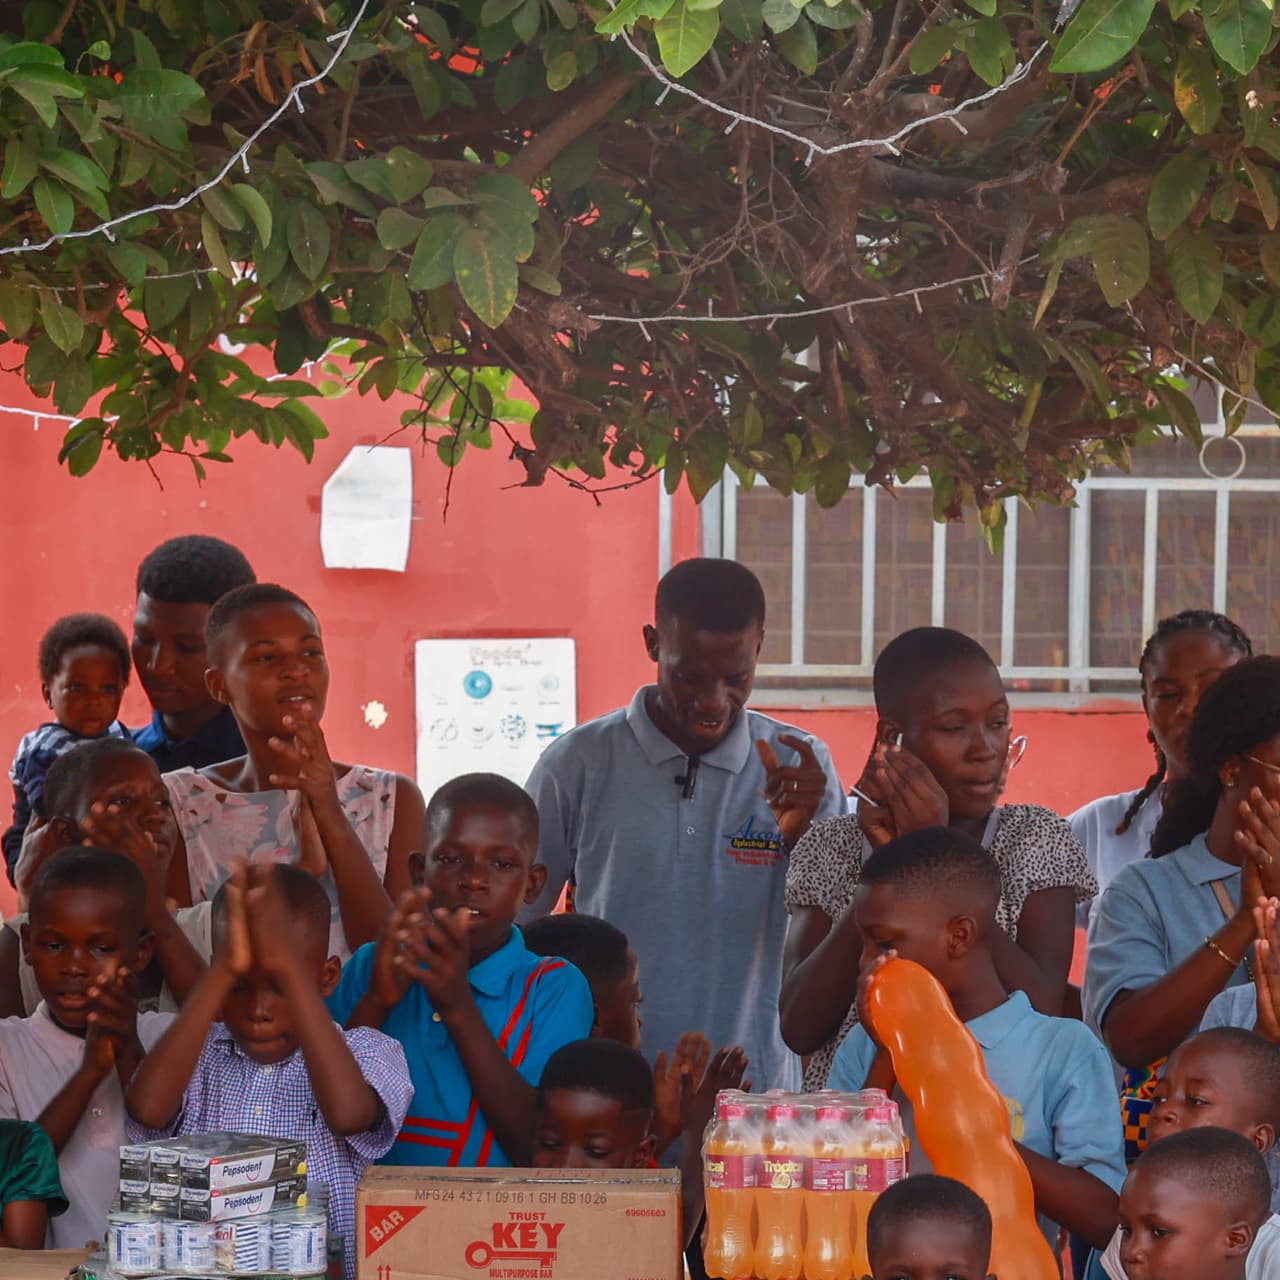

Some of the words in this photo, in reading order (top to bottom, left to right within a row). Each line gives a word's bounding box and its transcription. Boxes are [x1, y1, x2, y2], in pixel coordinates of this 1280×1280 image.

[222, 1161, 263, 1178] Pepsodent
[224, 1193, 263, 1210] Pepsodent
[508, 1211, 547, 1221] TRUST
[368, 1209, 405, 1242] BAR
[491, 1222, 566, 1249] KEY
[489, 1268, 538, 1279] MULTIPURPOSE
[538, 1268, 553, 1279] BAR
